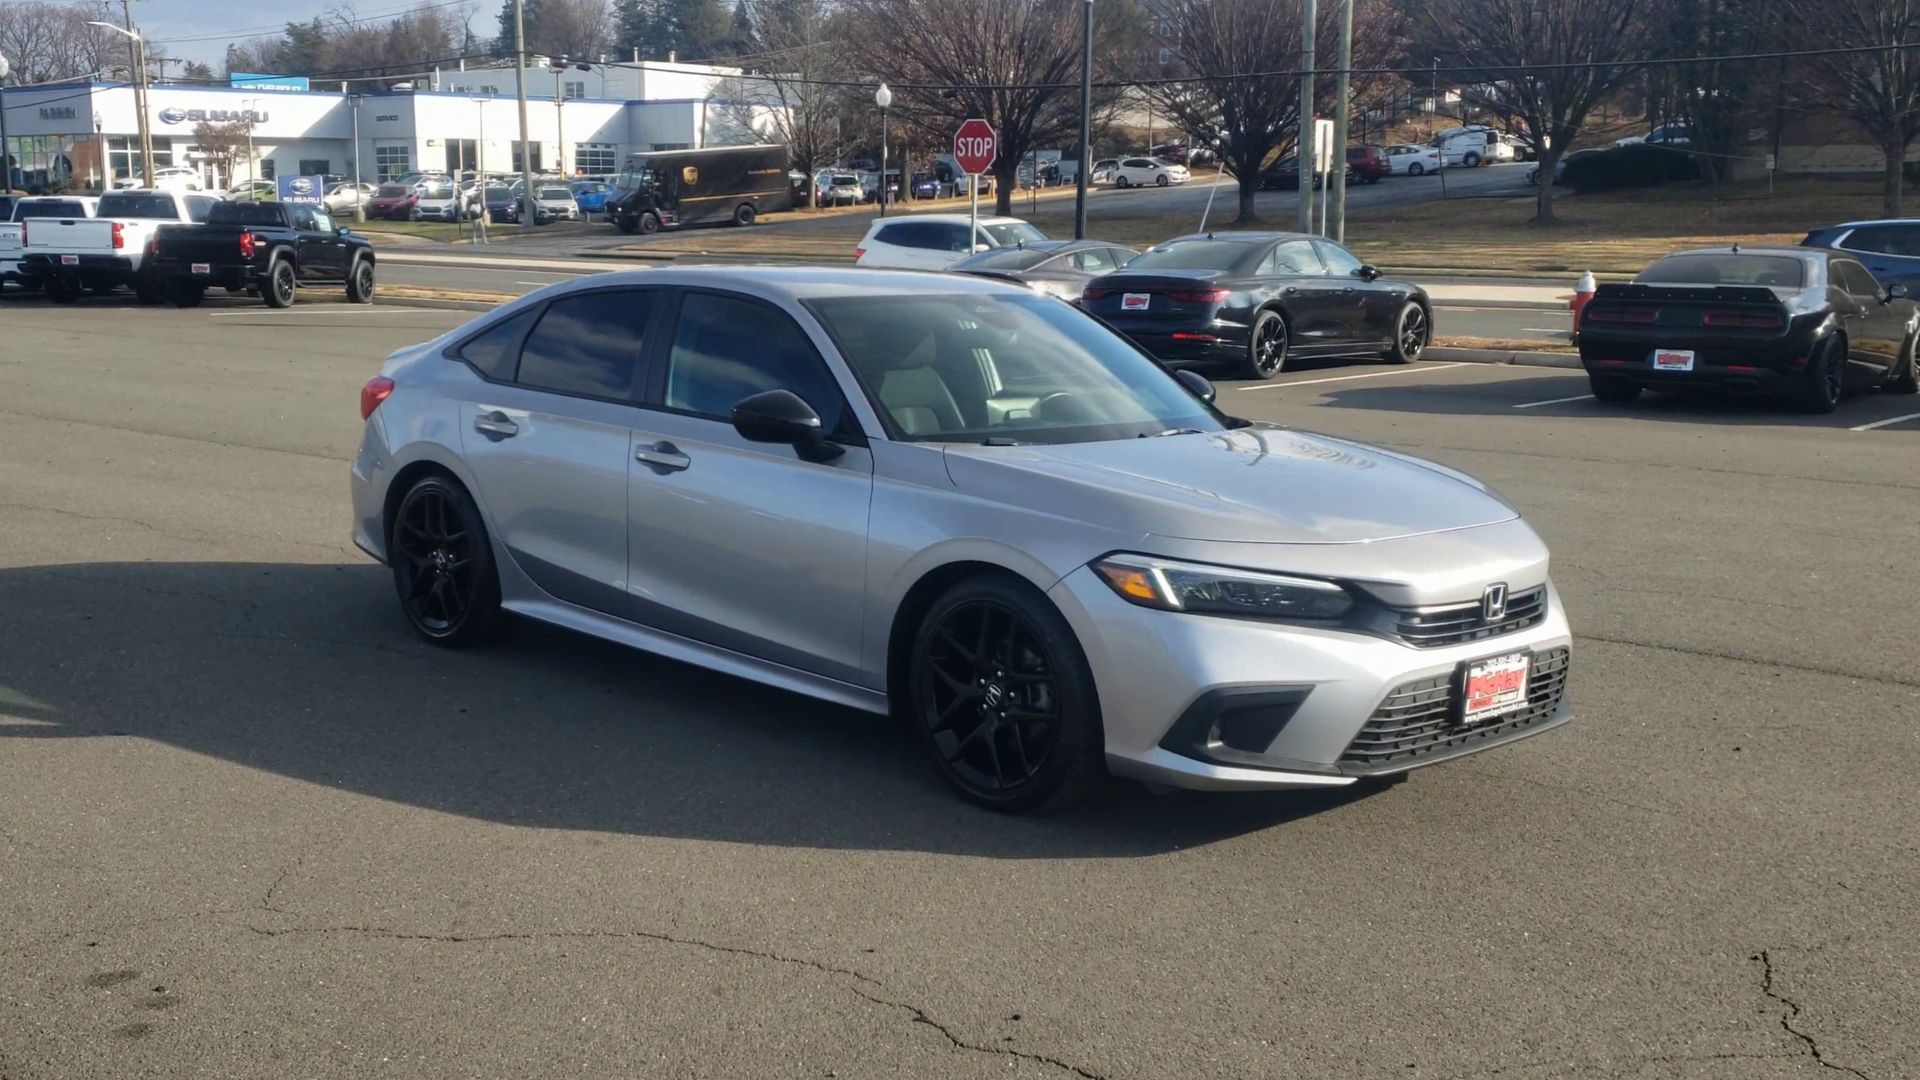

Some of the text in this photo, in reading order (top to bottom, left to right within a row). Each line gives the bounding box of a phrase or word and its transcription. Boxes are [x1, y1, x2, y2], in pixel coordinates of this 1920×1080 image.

[186, 109, 269, 123] SUBARU
[957, 137, 993, 157] STOP
[283, 196, 320, 204] SUBARU
